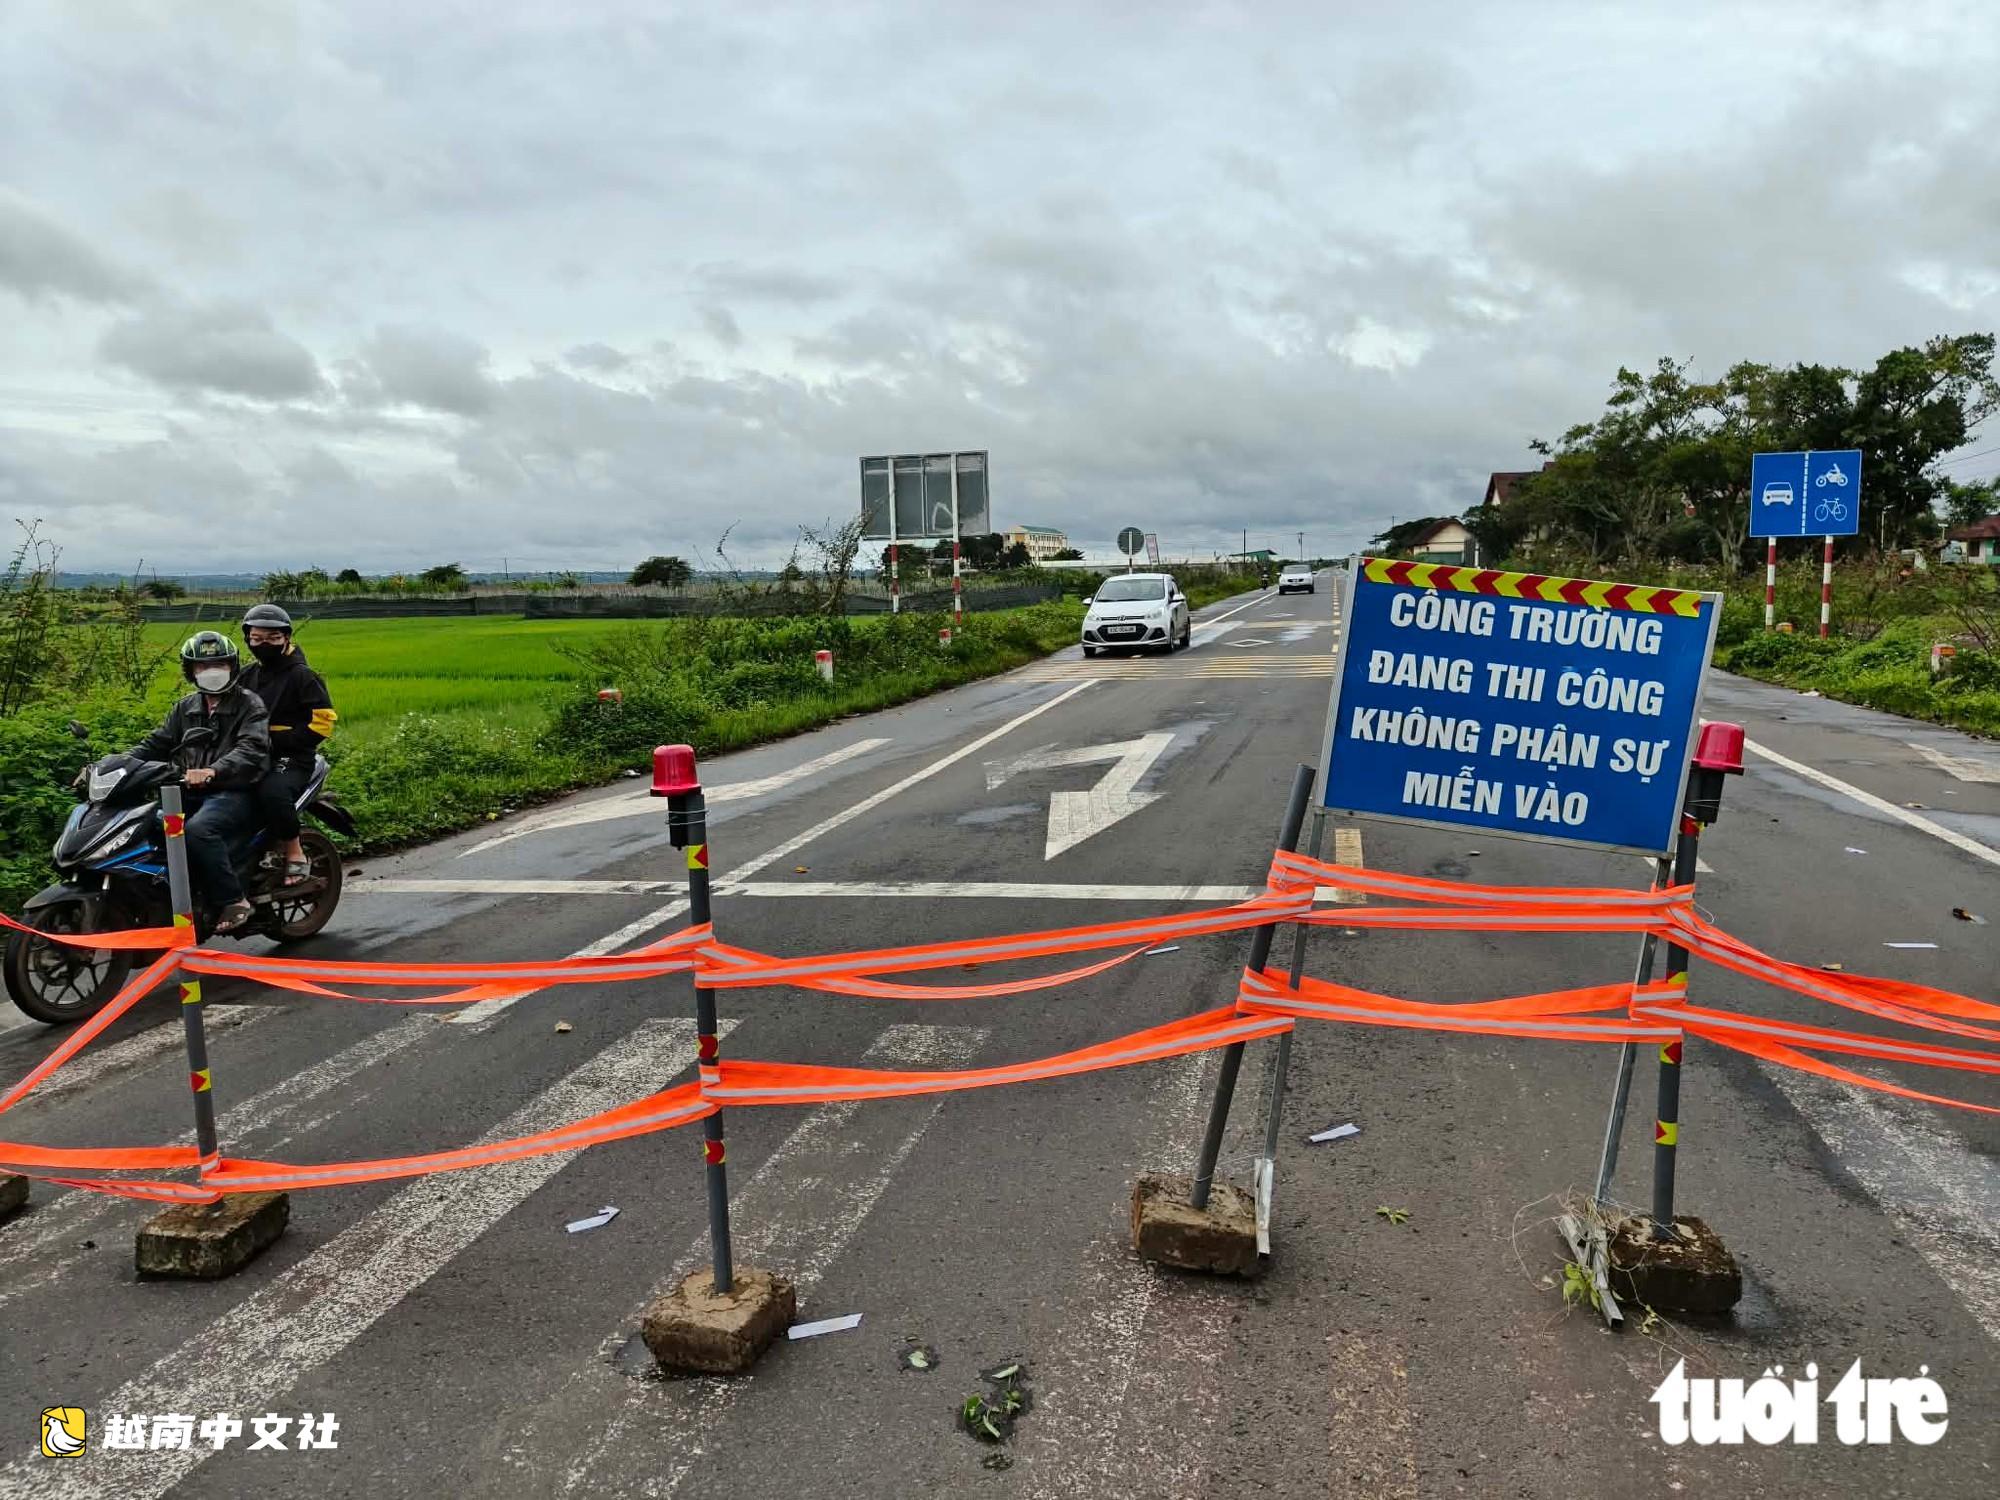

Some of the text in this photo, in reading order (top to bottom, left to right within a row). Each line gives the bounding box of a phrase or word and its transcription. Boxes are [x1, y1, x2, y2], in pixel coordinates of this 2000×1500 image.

[1390, 589, 1663, 655] CÔNG TRƯỜNG
[1368, 650, 1665, 716] ĐANG THI CÔNG
[1350, 706, 1671, 783] KHÔNG PHẬN SỰ
[1402, 766, 1589, 826] MIỄN VÀO
